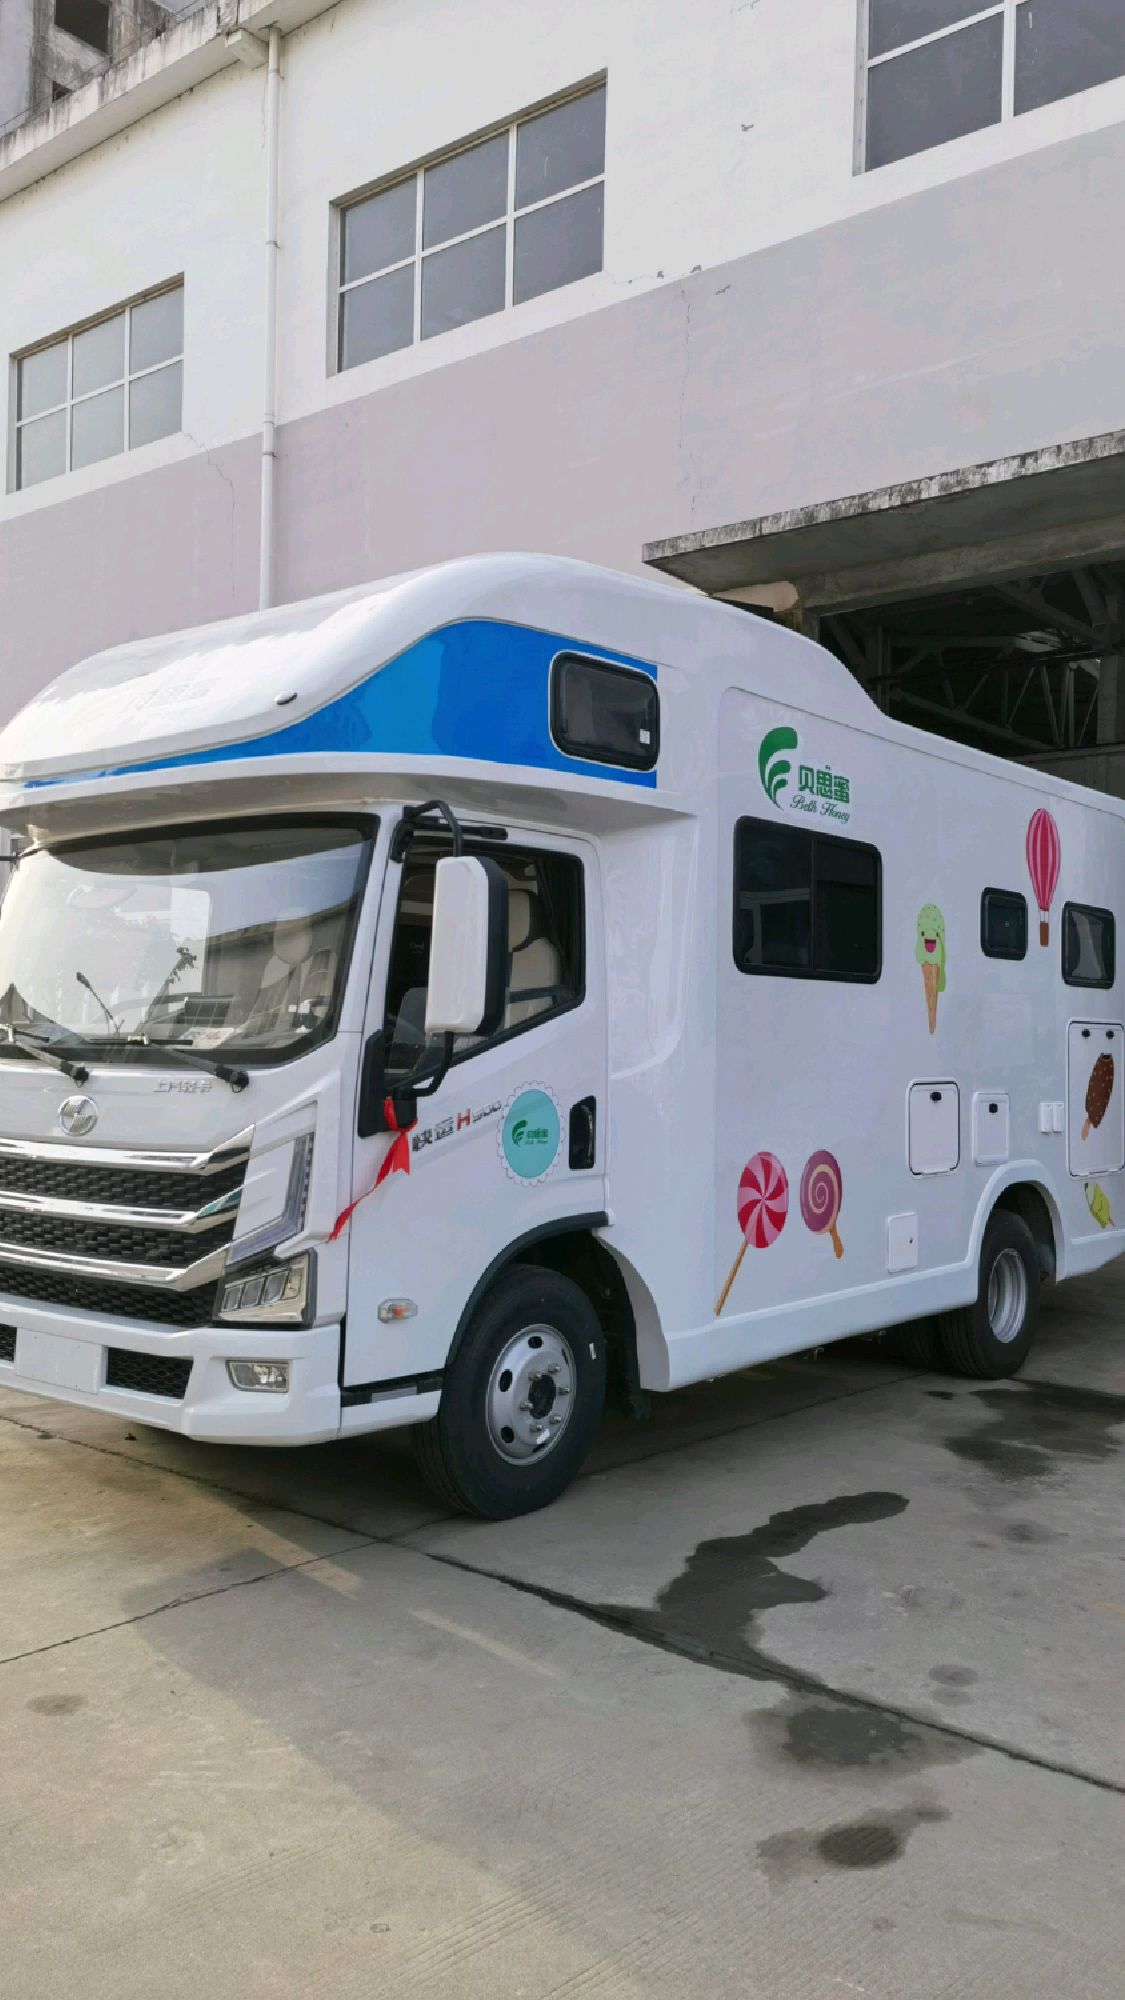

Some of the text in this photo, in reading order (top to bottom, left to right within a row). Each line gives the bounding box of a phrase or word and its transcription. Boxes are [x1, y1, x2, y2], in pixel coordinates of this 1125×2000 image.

[798, 765, 850, 804] 贝思蜜
[820, 803, 850, 824] Honey
